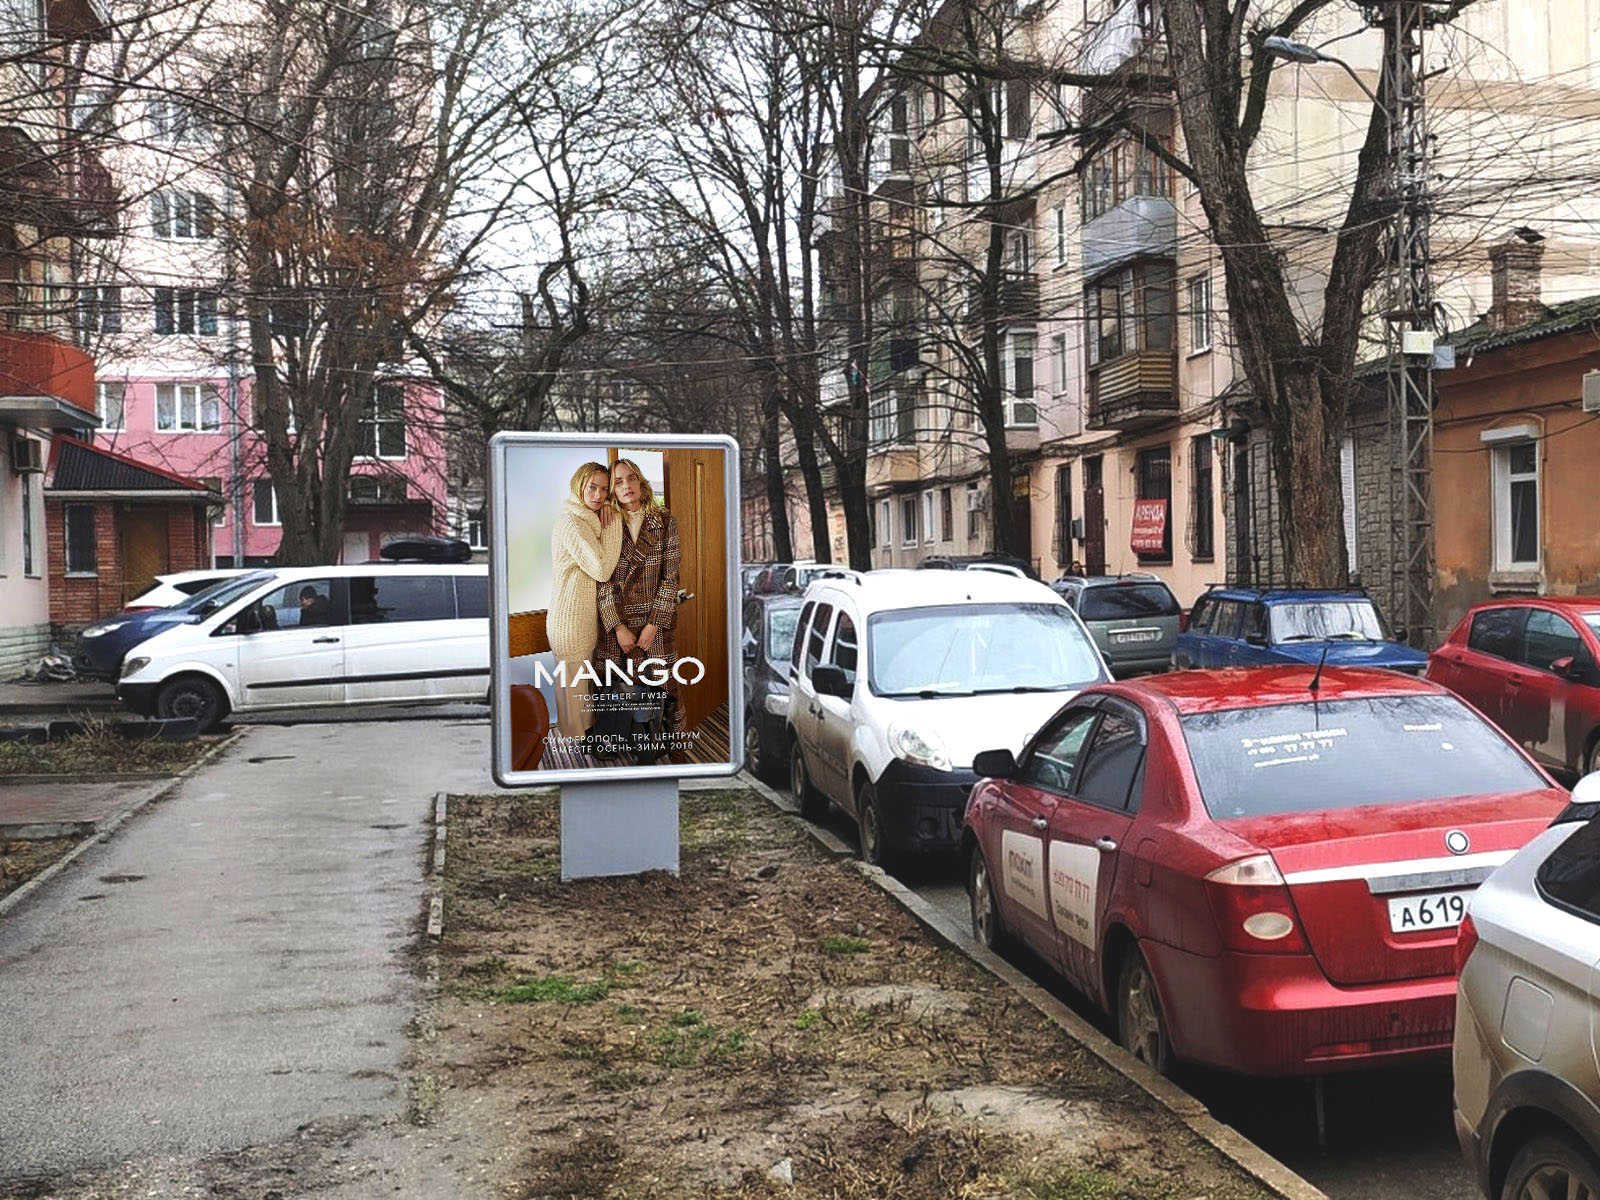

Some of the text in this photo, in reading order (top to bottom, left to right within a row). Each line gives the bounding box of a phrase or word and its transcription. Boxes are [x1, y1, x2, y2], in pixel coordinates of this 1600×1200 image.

[534, 656, 706, 689] MANGO
[632, 733, 650, 742] ТРК
[654, 731, 700, 742] ЦЕНТРУМ
[551, 742, 693, 754] ВМЕСТЕ ОСЕНЬ-ЗИМА 2018
